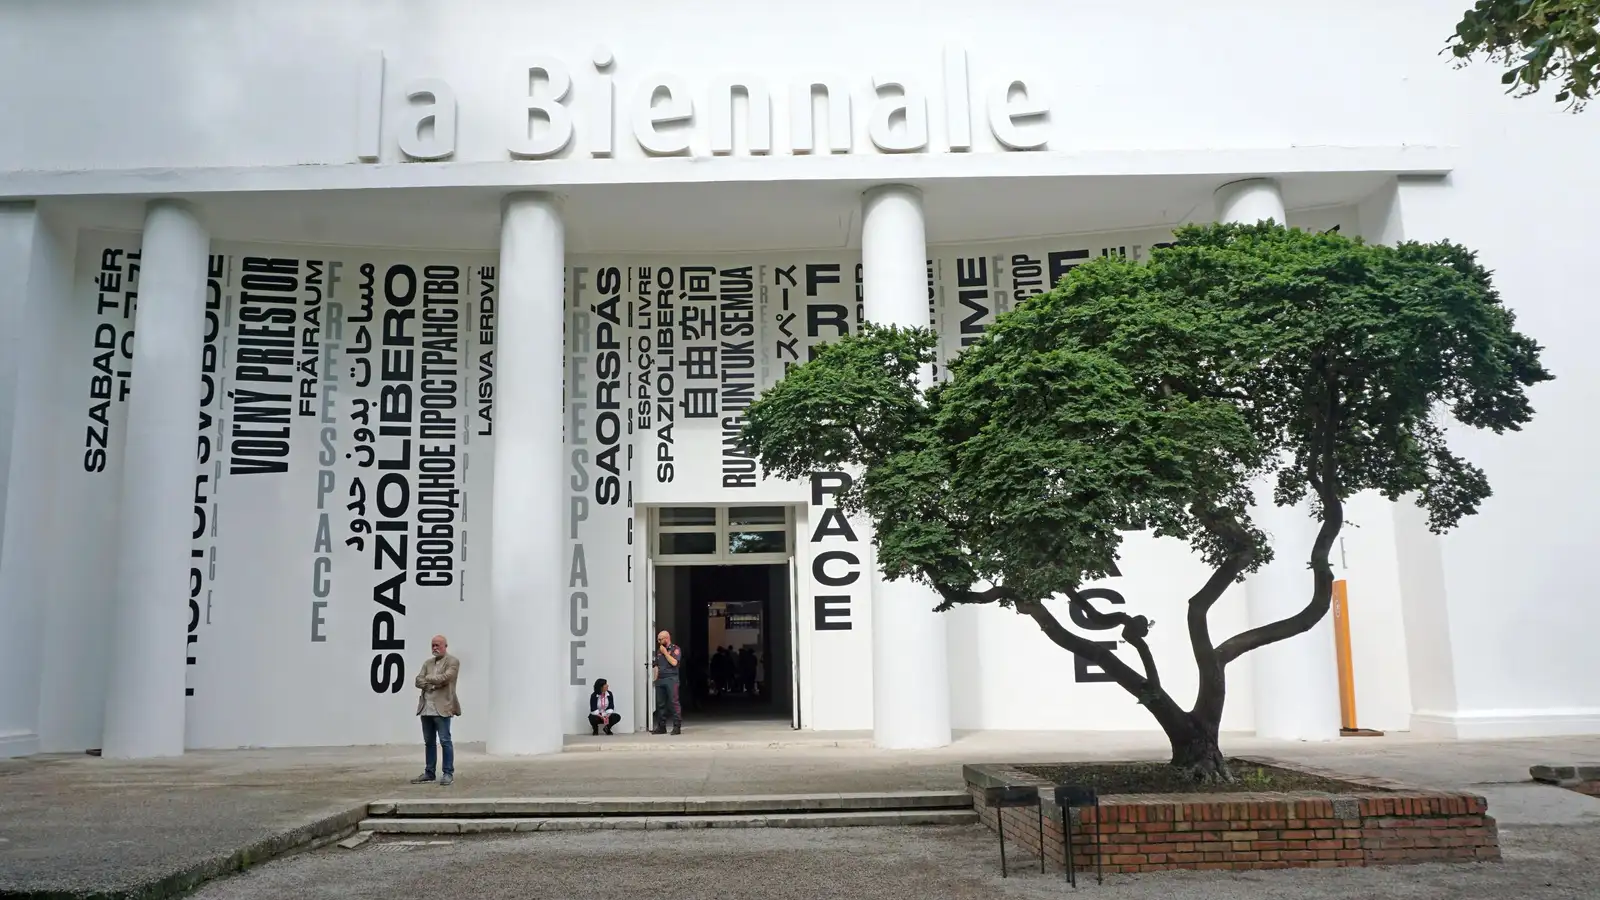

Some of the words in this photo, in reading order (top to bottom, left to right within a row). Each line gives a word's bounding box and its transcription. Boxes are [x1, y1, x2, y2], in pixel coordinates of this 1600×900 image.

[358, 50, 457, 162] la
[507, 45, 1051, 159] Biennale
[94, 248, 124, 315] TÉR
[236, 257, 299, 383] PRIESTOR
[297, 260, 324, 417] FRÄIRAUM
[419, 265, 460, 439] ПРОСТРАНСТВО
[638, 266, 652, 330] LIVRE
[719, 265, 754, 337] SEMUA
[84, 323, 116, 473] SZABAD
[478, 351, 493, 436] LAISVA
[591, 266, 621, 506] SAORSPÁS
[638, 335, 656, 430] ESPAÇO
[656, 266, 675, 483] SPAZIOLIBERO
[720, 340, 755, 412] UNTUK
[311, 261, 343, 642] FREESPACE
[370, 264, 417, 694] SPAZIOLIBERO
[416, 444, 460, 587] СВОБОДНОЕ
[569, 266, 590, 686] FREESPACE
